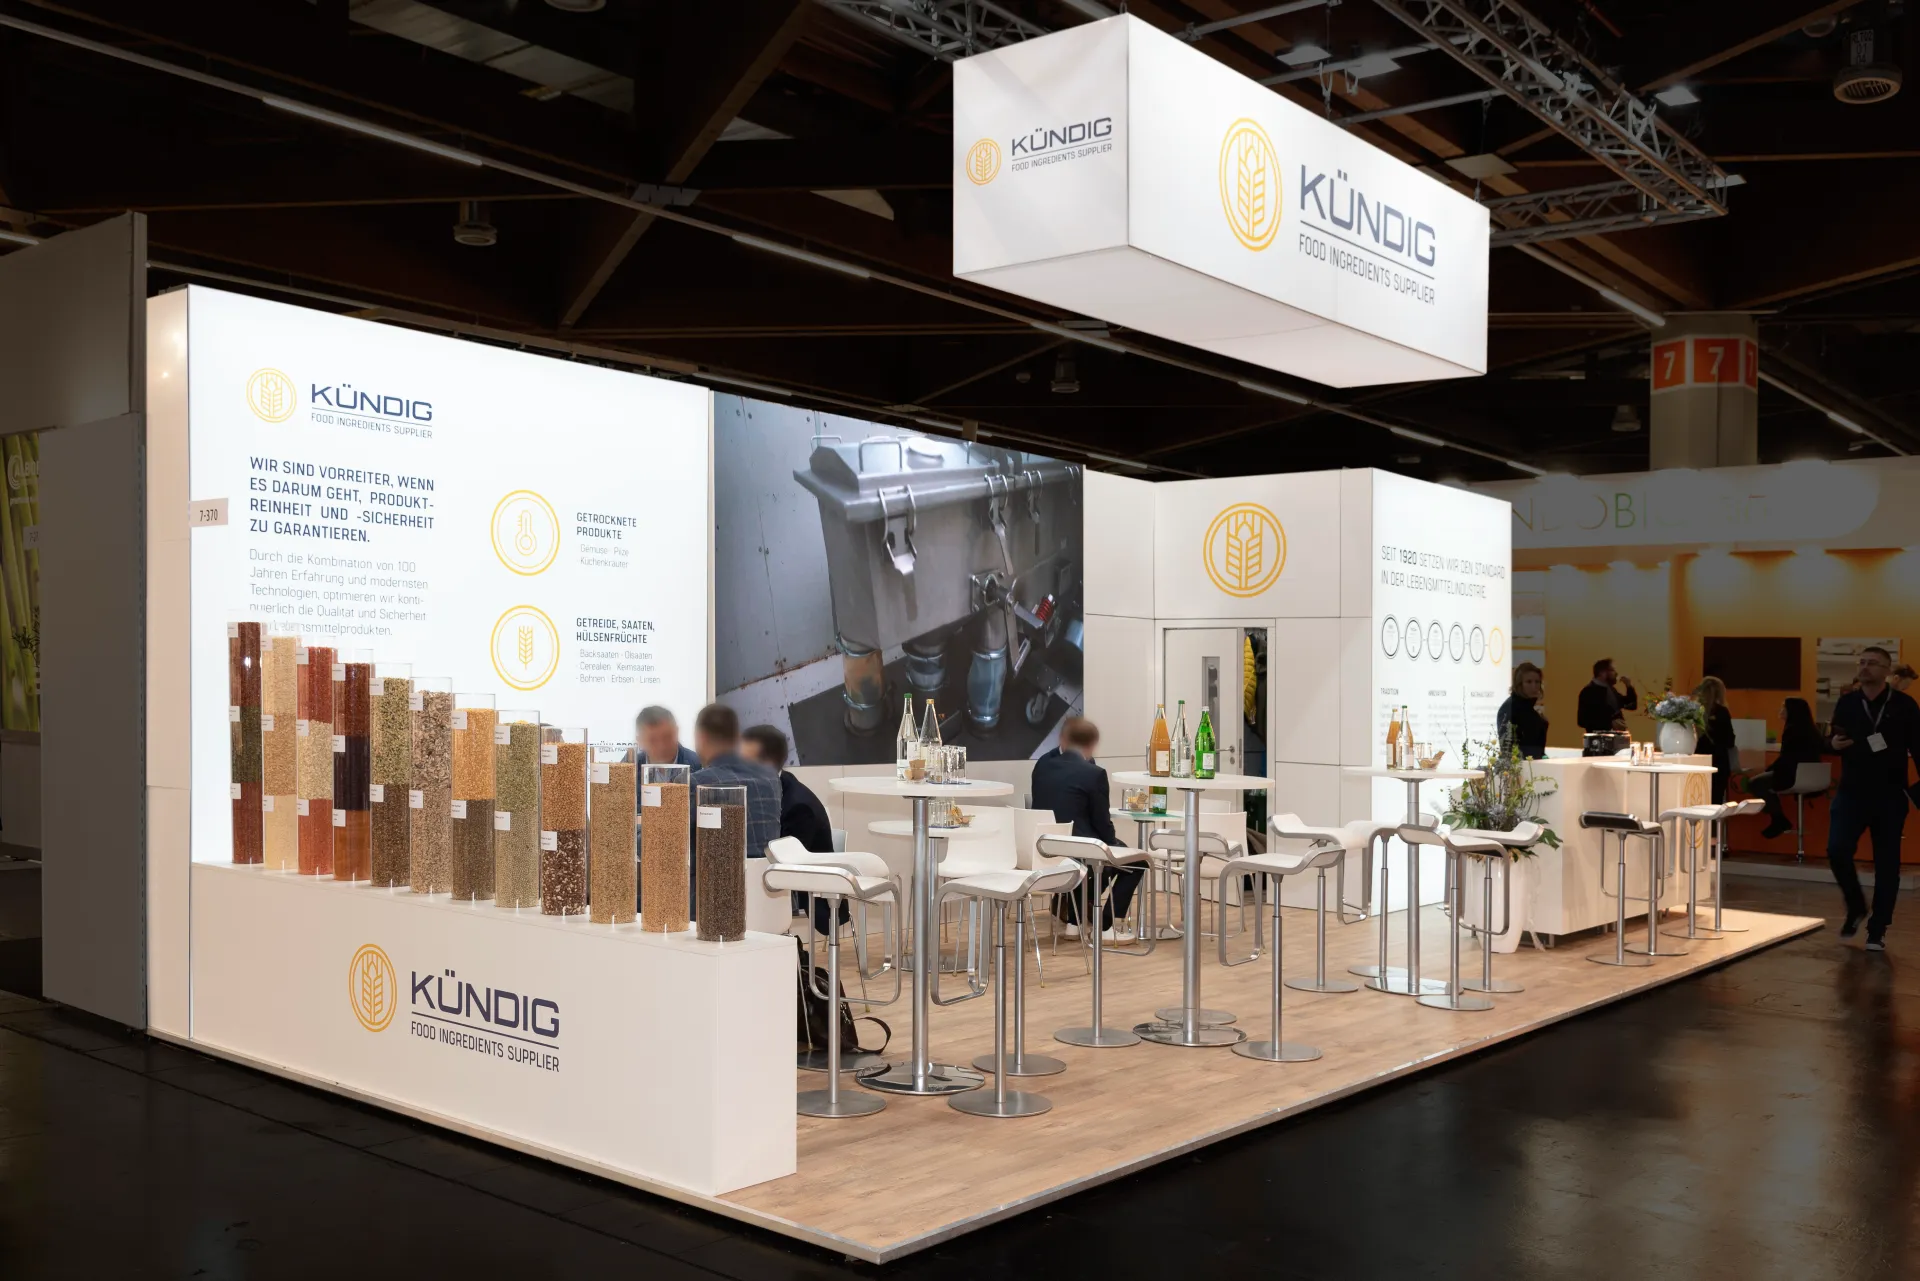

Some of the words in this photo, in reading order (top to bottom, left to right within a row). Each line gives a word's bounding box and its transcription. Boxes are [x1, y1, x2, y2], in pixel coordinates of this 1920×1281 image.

[1012, 117, 1112, 156] KÜNDIG
[1011, 160, 1030, 172] FOOD
[1031, 150, 1076, 169] INGREDIENTS
[1078, 143, 1112, 160] SUPPLIER
[1300, 164, 1436, 268] KÜNDIG
[1299, 233, 1326, 261] FOOD
[1329, 245, 1390, 288] INGREDIENTS
[1394, 273, 1435, 306] SUPPLIER
[1663, 351, 1676, 380] 7
[1708, 347, 1724, 376] 7
[312, 383, 432, 422] KÜNDIG
[311, 412, 334, 425] FOOD
[337, 416, 391, 432] INGREDIENTS
[394, 425, 432, 439] SUPPLIER
[250, 456, 278, 472] WIR
[283, 461, 314, 477] SIND
[319, 466, 394, 488] VORREITER,
[398, 475, 434, 491] WENN
[250, 478, 267, 492] ES
[272, 480, 321, 498] DARUM
[326, 486, 362, 504] GEHT,
[370, 492, 434, 509] PRODUKT-
[200, 508, 218, 522] 7-370
[250, 498, 311, 516] REINHEIT
[321, 506, 348, 520] UND
[356, 511, 434, 529] -SICHERHEIT
[577, 512, 637, 528] GETROCKNETE
[250, 518, 268, 533] ZU
[274, 522, 370, 542] GARANTIEREN.
[577, 526, 622, 539] PRODUKTE
[250, 548, 282, 563] Durch
[288, 553, 303, 564] die
[307, 554, 372, 569] Kombination
[376, 561, 394, 571] von
[398, 562, 416, 572] 100
[1381, 546, 1396, 560] SEIT
[1400, 549, 1417, 565] 1920
[1419, 553, 1444, 570] SETZEN
[1446, 557, 1459, 572] WIR
[1461, 560, 1473, 575] DEN
[1475, 562, 1505, 579] STANDARD
[250, 566, 288, 580] Jahren
[291, 570, 344, 585] Erfahrung
[348, 574, 366, 586] und
[370, 576, 428, 589] modernsten
[1381, 570, 1388, 585] IN
[1391, 571, 1405, 586] DER
[250, 584, 320, 600] Technologien,
[323, 589, 376, 604] optimieren
[379, 594, 395, 604] wir
[398, 592, 424, 605] konti-
[298, 604, 314, 616] die
[358, 608, 376, 619] und
[379, 608, 426, 621] Sicherheit
[576, 618, 619, 631] GETREIDE,
[622, 620, 655, 632] SAATEN,
[576, 630, 648, 644] HÜLSENFRÜCHTE
[580, 649, 619, 660] Backsaaten
[611, 674, 634, 684] Erbsen
[411, 968, 560, 1038] KÜNDIG
[411, 1020, 436, 1040] FOOD
[439, 1028, 504, 1058] INGREDIENTS
[507, 1045, 560, 1072] SUPPLIER
